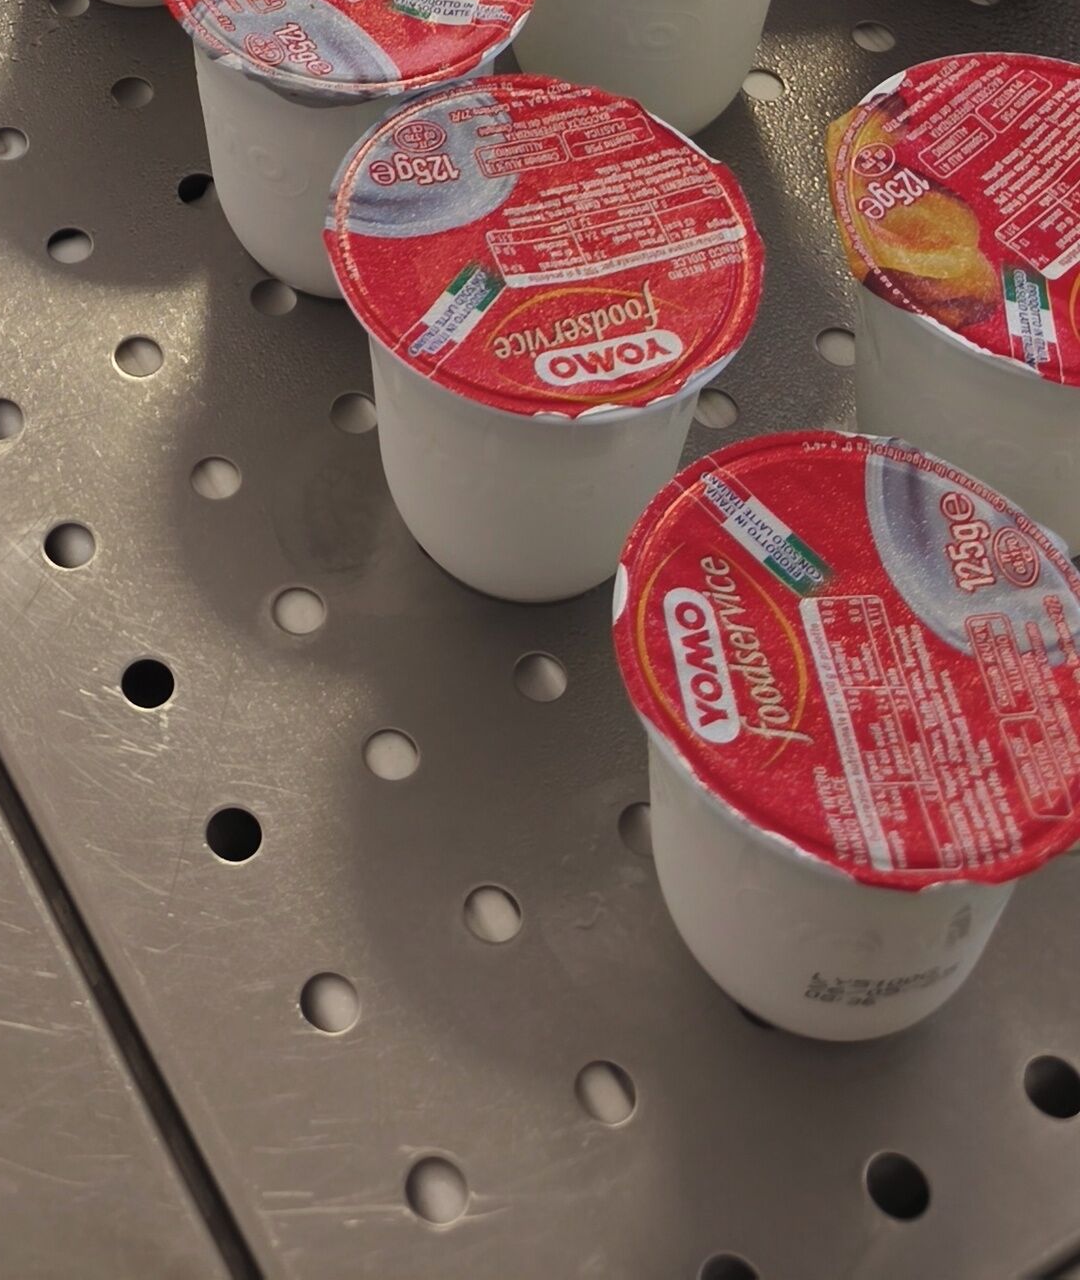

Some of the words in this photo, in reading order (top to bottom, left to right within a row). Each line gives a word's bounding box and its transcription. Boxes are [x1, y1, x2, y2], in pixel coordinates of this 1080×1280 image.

[583, 120, 626, 136] PLASTICA
[670, 249, 705, 264] DOLCE
[493, 279, 660, 361] foodservice
[548, 344, 672, 379] YOMO
[741, 505, 775, 537] LATTE
[746, 523, 803, 581] PRODOTTO
[673, 604, 727, 728] YOMO
[710, 556, 814, 745] foodservice
